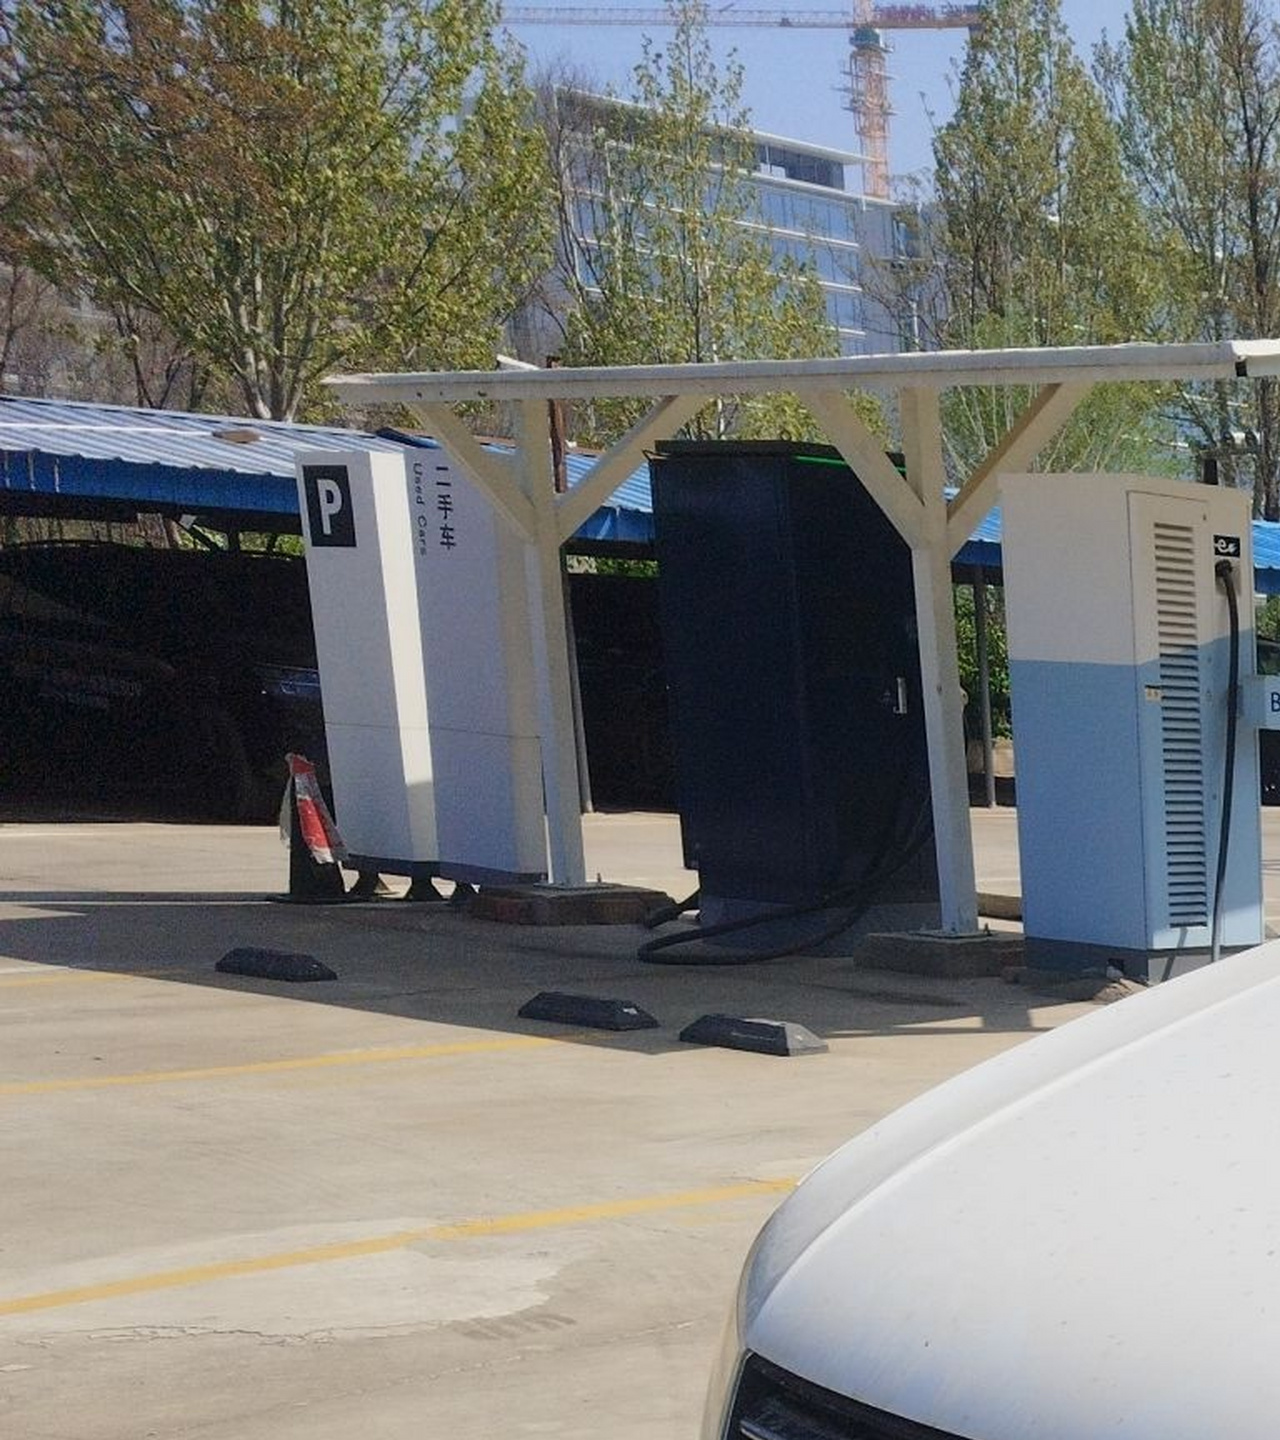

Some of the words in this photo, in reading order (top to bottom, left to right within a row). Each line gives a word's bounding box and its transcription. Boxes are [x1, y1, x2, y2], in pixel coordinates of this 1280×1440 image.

[316, 479, 343, 535] P
[413, 463, 425, 505] Used
[436, 466, 456, 549] 二手车
[417, 515, 428, 556] Cars
